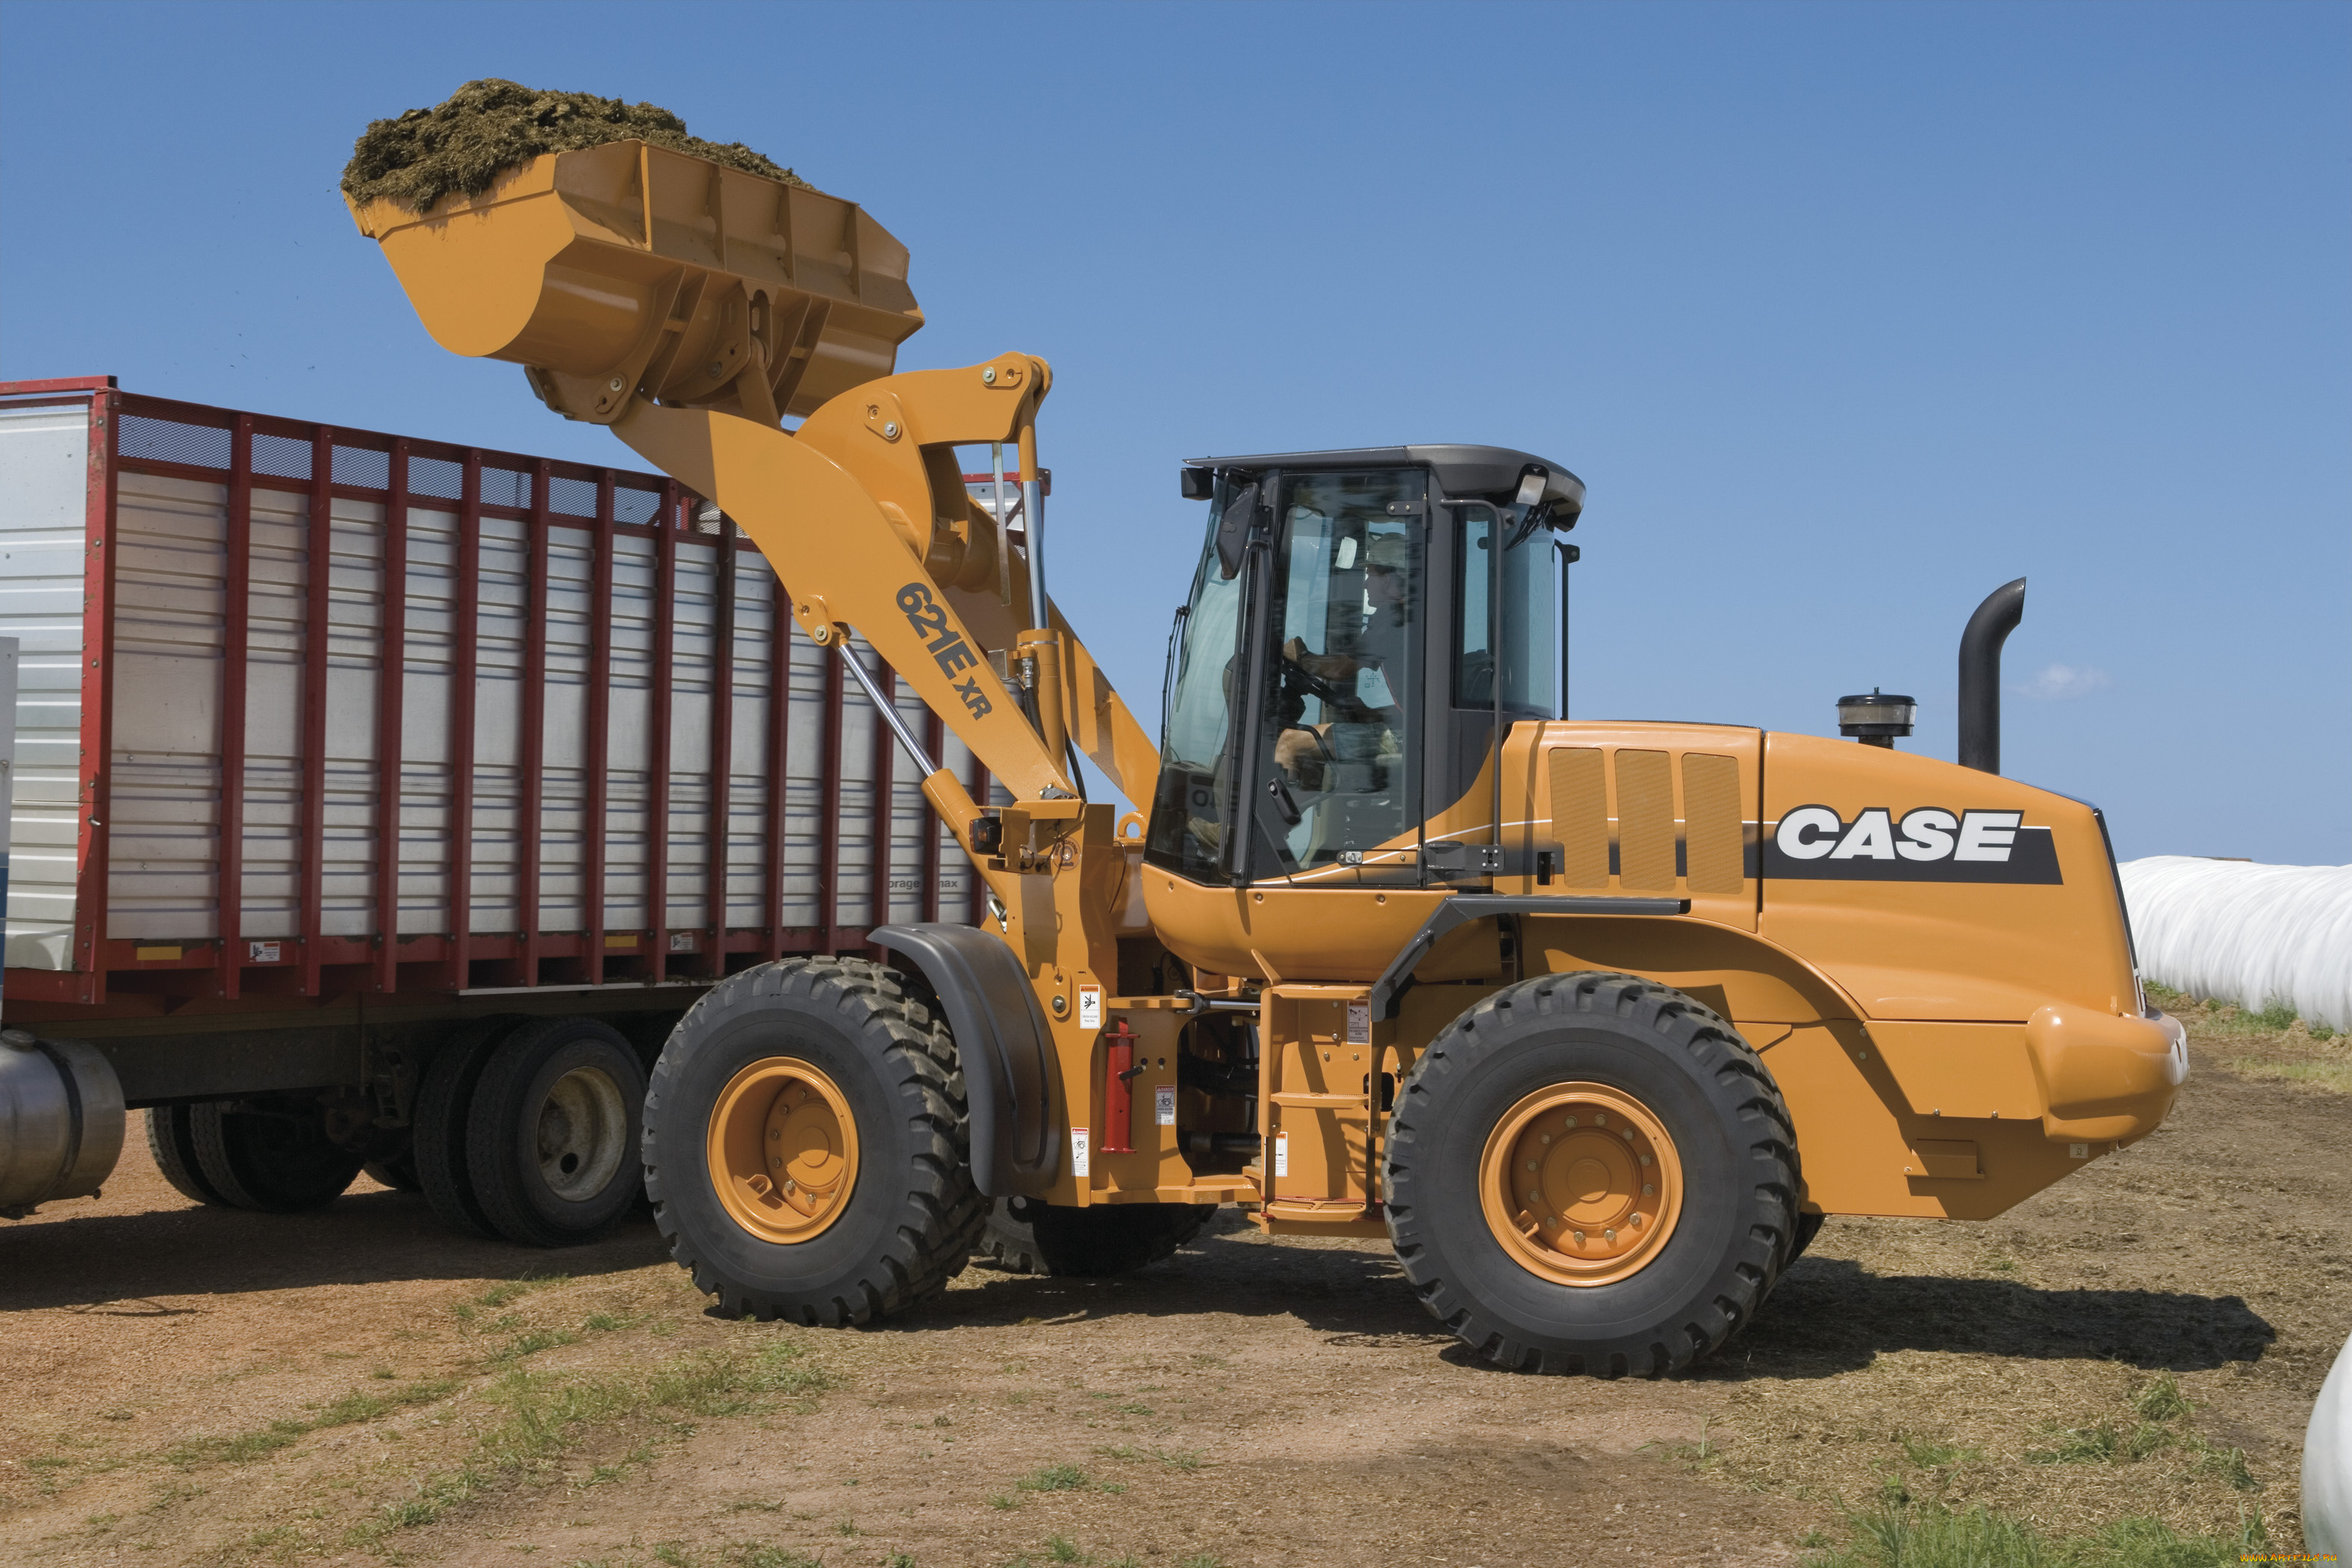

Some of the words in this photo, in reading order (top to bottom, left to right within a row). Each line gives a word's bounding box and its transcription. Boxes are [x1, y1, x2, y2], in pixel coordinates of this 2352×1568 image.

[896, 582, 978, 680] 621E
[953, 676, 992, 721] XR
[1776, 806, 2023, 862] CASE
[889, 880, 920, 890] orage
